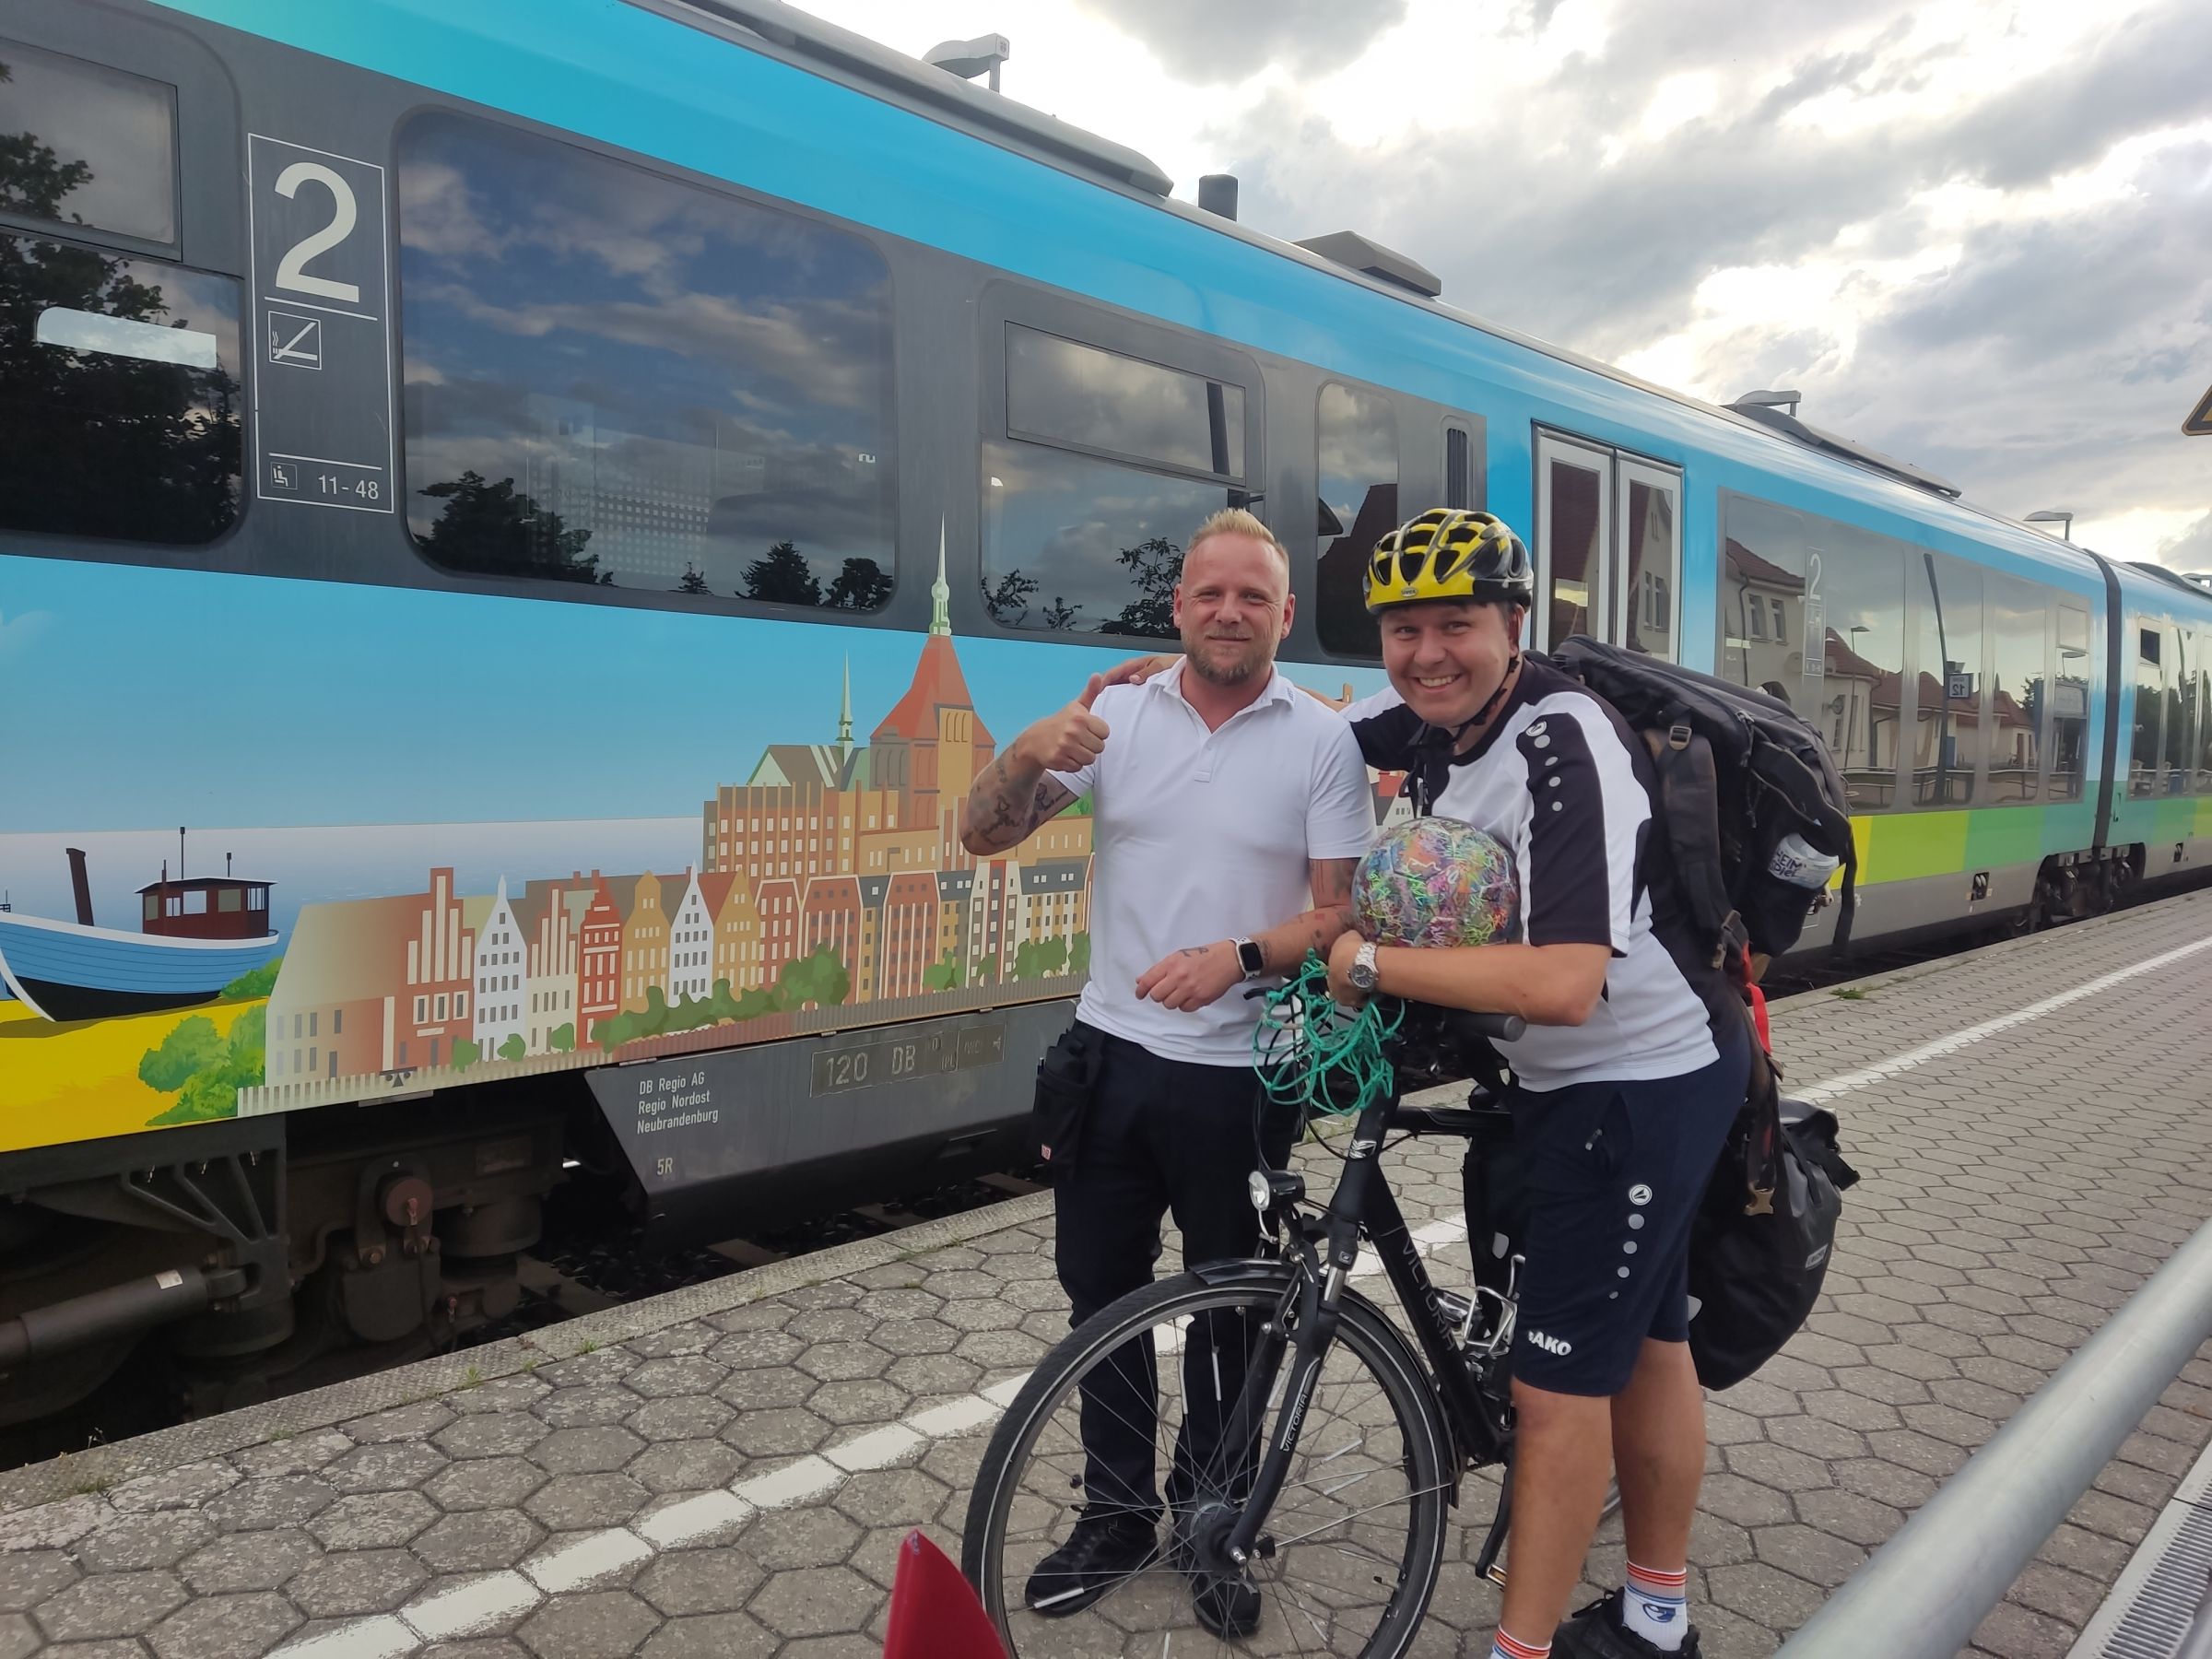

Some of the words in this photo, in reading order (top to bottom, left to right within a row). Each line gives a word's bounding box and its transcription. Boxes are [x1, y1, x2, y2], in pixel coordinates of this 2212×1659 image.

[275, 162, 359, 303] 2
[355, 479, 379, 500] 48
[1809, 553, 1822, 601] 2
[826, 1052, 868, 1087] 120
[891, 1045, 915, 1075] DB
[638, 1080, 653, 1095] DB
[659, 1075, 686, 1093] Regio
[691, 1071, 705, 1087] AG
[638, 1098, 666, 1115] Regio
[672, 1089, 711, 1109] Nordost
[637, 1109, 719, 1135] Neubrandenburg
[657, 1158, 673, 1175] 5R
[1283, 1394, 1308, 1452] VICTORIA
